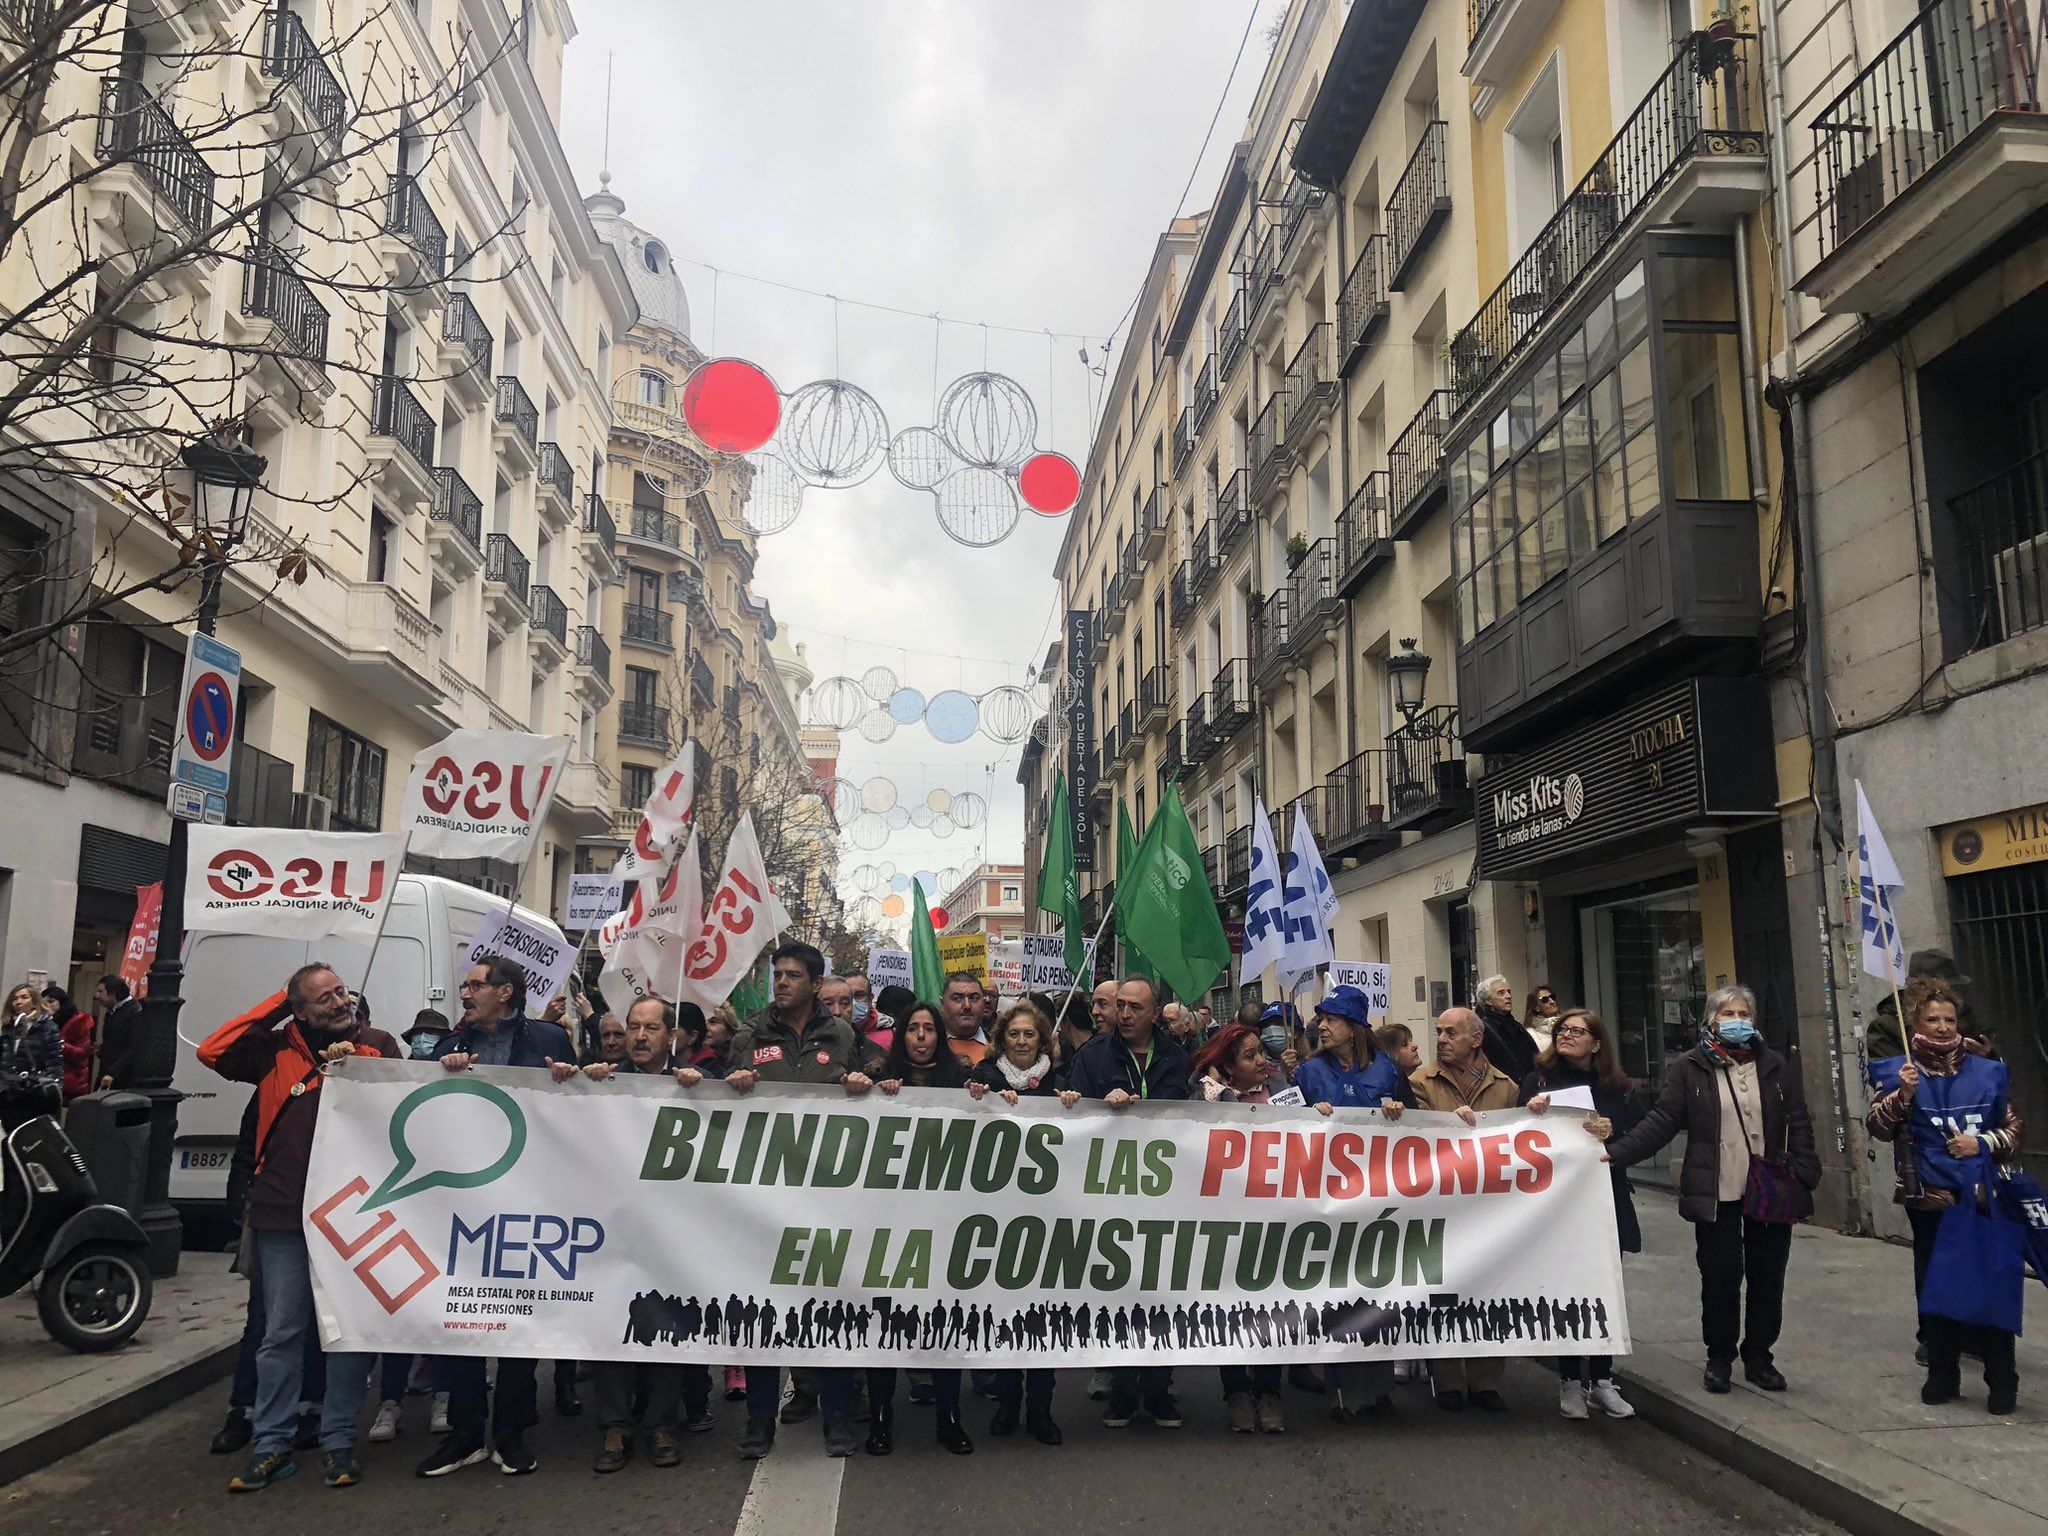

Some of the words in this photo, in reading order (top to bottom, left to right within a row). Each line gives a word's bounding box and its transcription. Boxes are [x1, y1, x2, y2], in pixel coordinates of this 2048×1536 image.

[1076, 619, 1085, 708] CATALONIA
[1076, 712, 1086, 772] PUERTA
[1629, 713, 1686, 762] ATOCHA
[1648, 760, 1665, 789] 31
[1077, 777, 1086, 807] DEL
[1493, 790, 1528, 828] Miss
[1530, 775, 1562, 814] Kits
[1076, 812, 1087, 843] SOL
[1496, 833, 1507, 850] Tu
[1507, 824, 1529, 846] tienda
[1530, 820, 1540, 839] de
[1541, 817, 1563, 836] lanas
[491, 925, 559, 967] ¡PENSIONES
[1023, 937, 1063, 958] RETAURAR
[988, 970, 1020, 980] ENSIONE
[993, 959, 1003, 968] En
[1033, 965, 1048, 984] LAS
[1337, 969, 1370, 988] VIEJO,
[1373, 968, 1386, 989] SÍ;
[1372, 993, 1390, 1009] NO.
[190, 1153, 228, 1167] 8887
[638, 1105, 1064, 1196] BLINDEMOS
[1083, 1137, 1177, 1198] LAS
[1200, 1128, 1554, 1200] PENSIONES
[446, 1212, 606, 1281] MERP
[769, 1226, 853, 1288] EN
[861, 1227, 934, 1290] LA
[946, 1207, 1446, 1292] CONSTITUCIÓN
[448, 1286, 474, 1298] MESA
[477, 1287, 513, 1299] ESTATAL
[516, 1289, 535, 1300] POR
[537, 1290, 548, 1300] EL
[550, 1290, 594, 1302] BLINDAJE
[446, 1302, 459, 1313] DE
[461, 1303, 478, 1314] LAS
[480, 1303, 533, 1316] PENSIONES
[443, 1321, 507, 1333] www.merp.es
